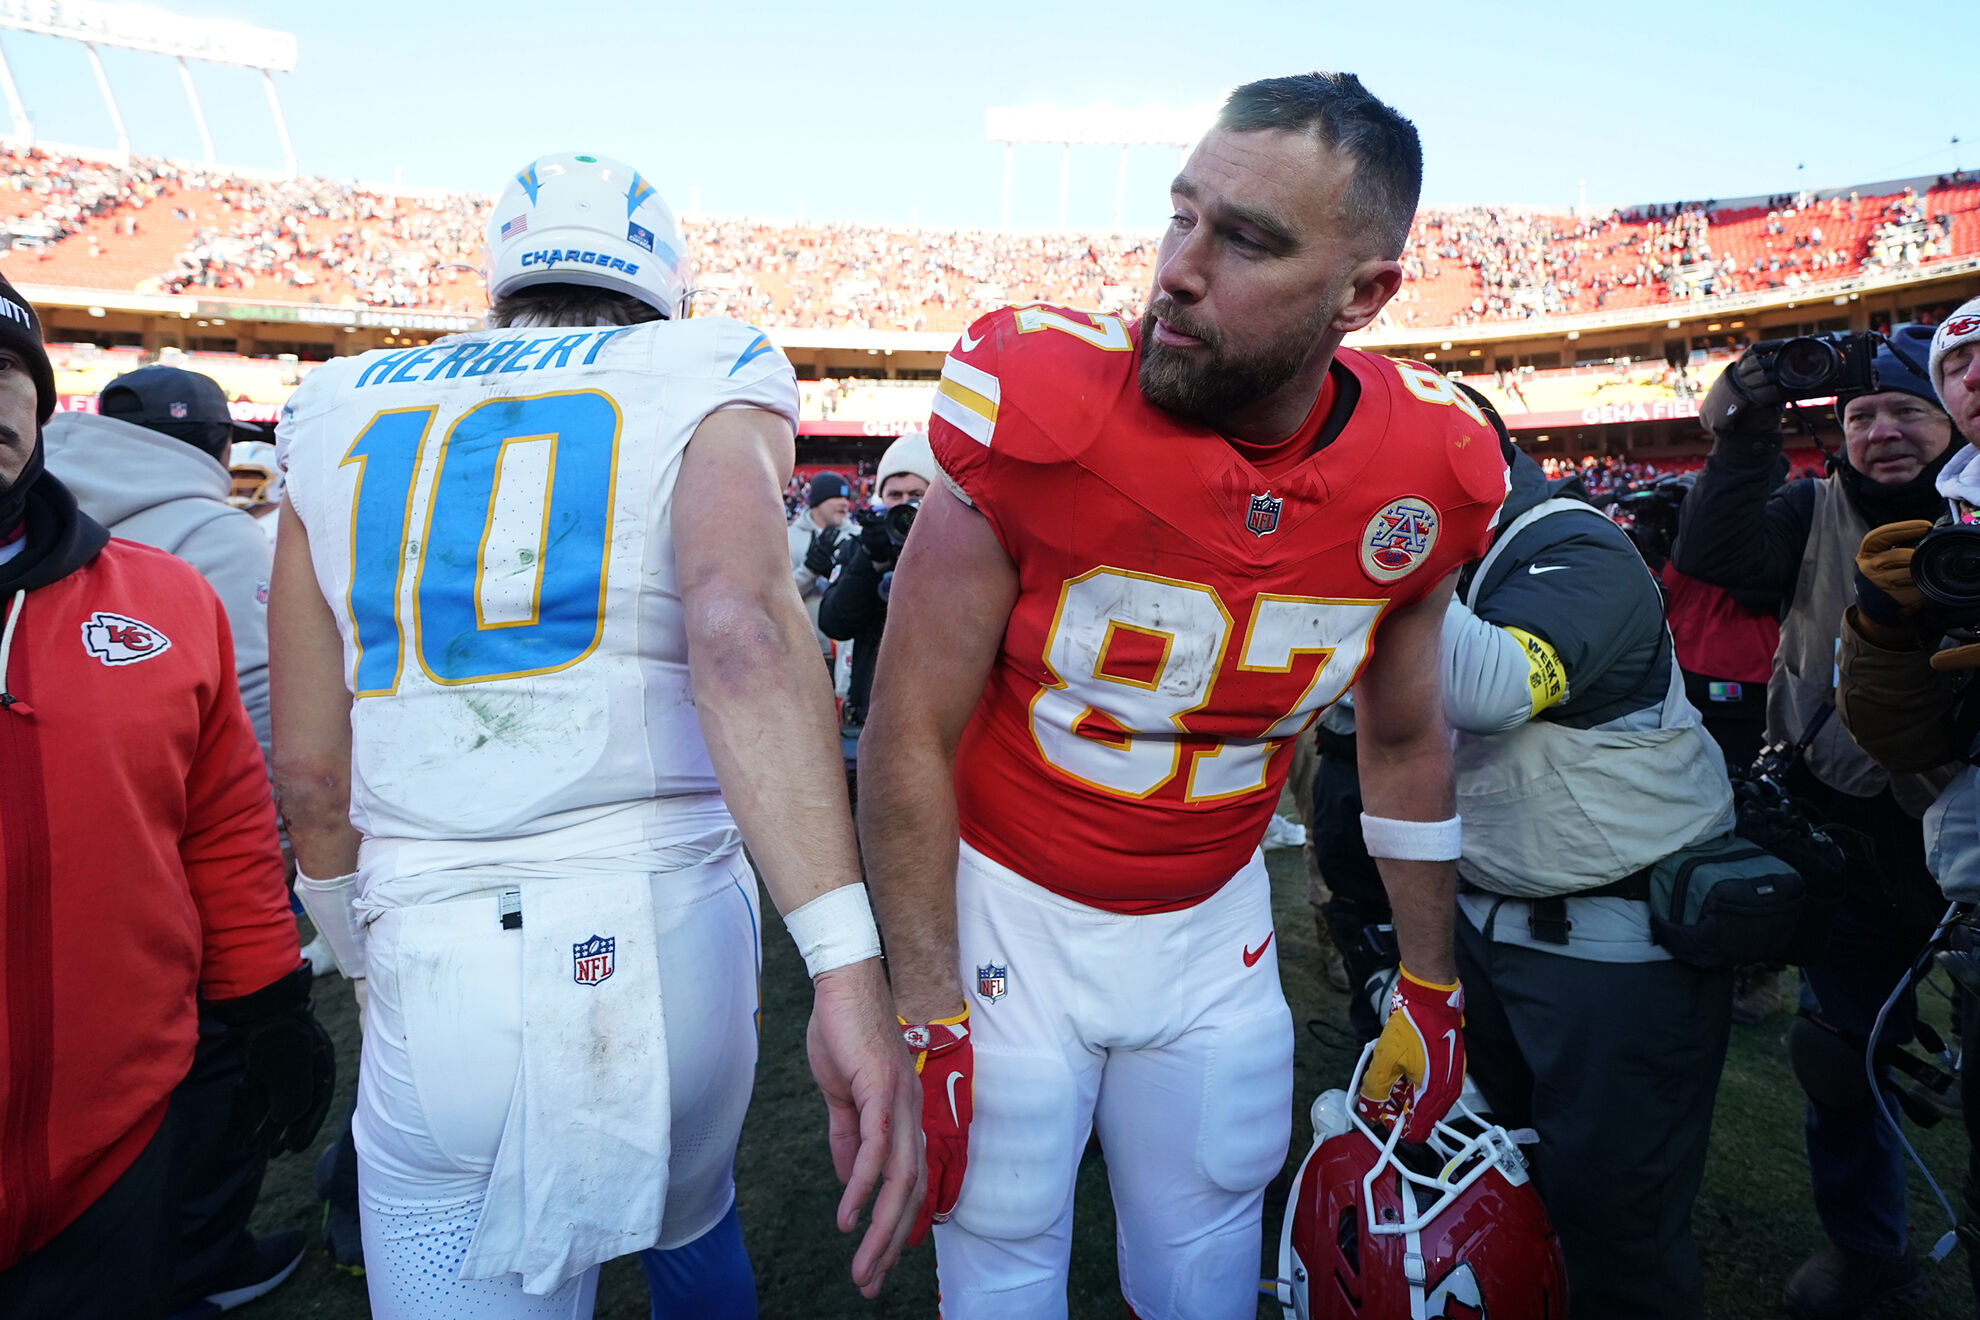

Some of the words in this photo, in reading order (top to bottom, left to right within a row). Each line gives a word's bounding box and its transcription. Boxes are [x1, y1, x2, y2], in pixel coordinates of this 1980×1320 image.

[521, 249, 640, 276] CHARGERS
[354, 326, 632, 389] HERBERT
[1582, 405, 1650, 425] GEHA
[1653, 399, 1700, 420] FIEL
[863, 421, 918, 436] GEHA
[1250, 511, 1274, 529] NFL
[338, 388, 623, 699] 10
[105, 625, 153, 651] KC
[1528, 638, 1558, 684] WEEK
[1550, 680, 1561, 697] 15
[1029, 565, 1391, 804] 87
[577, 955, 612, 981] NFL
[981, 979, 1004, 997] NFL
